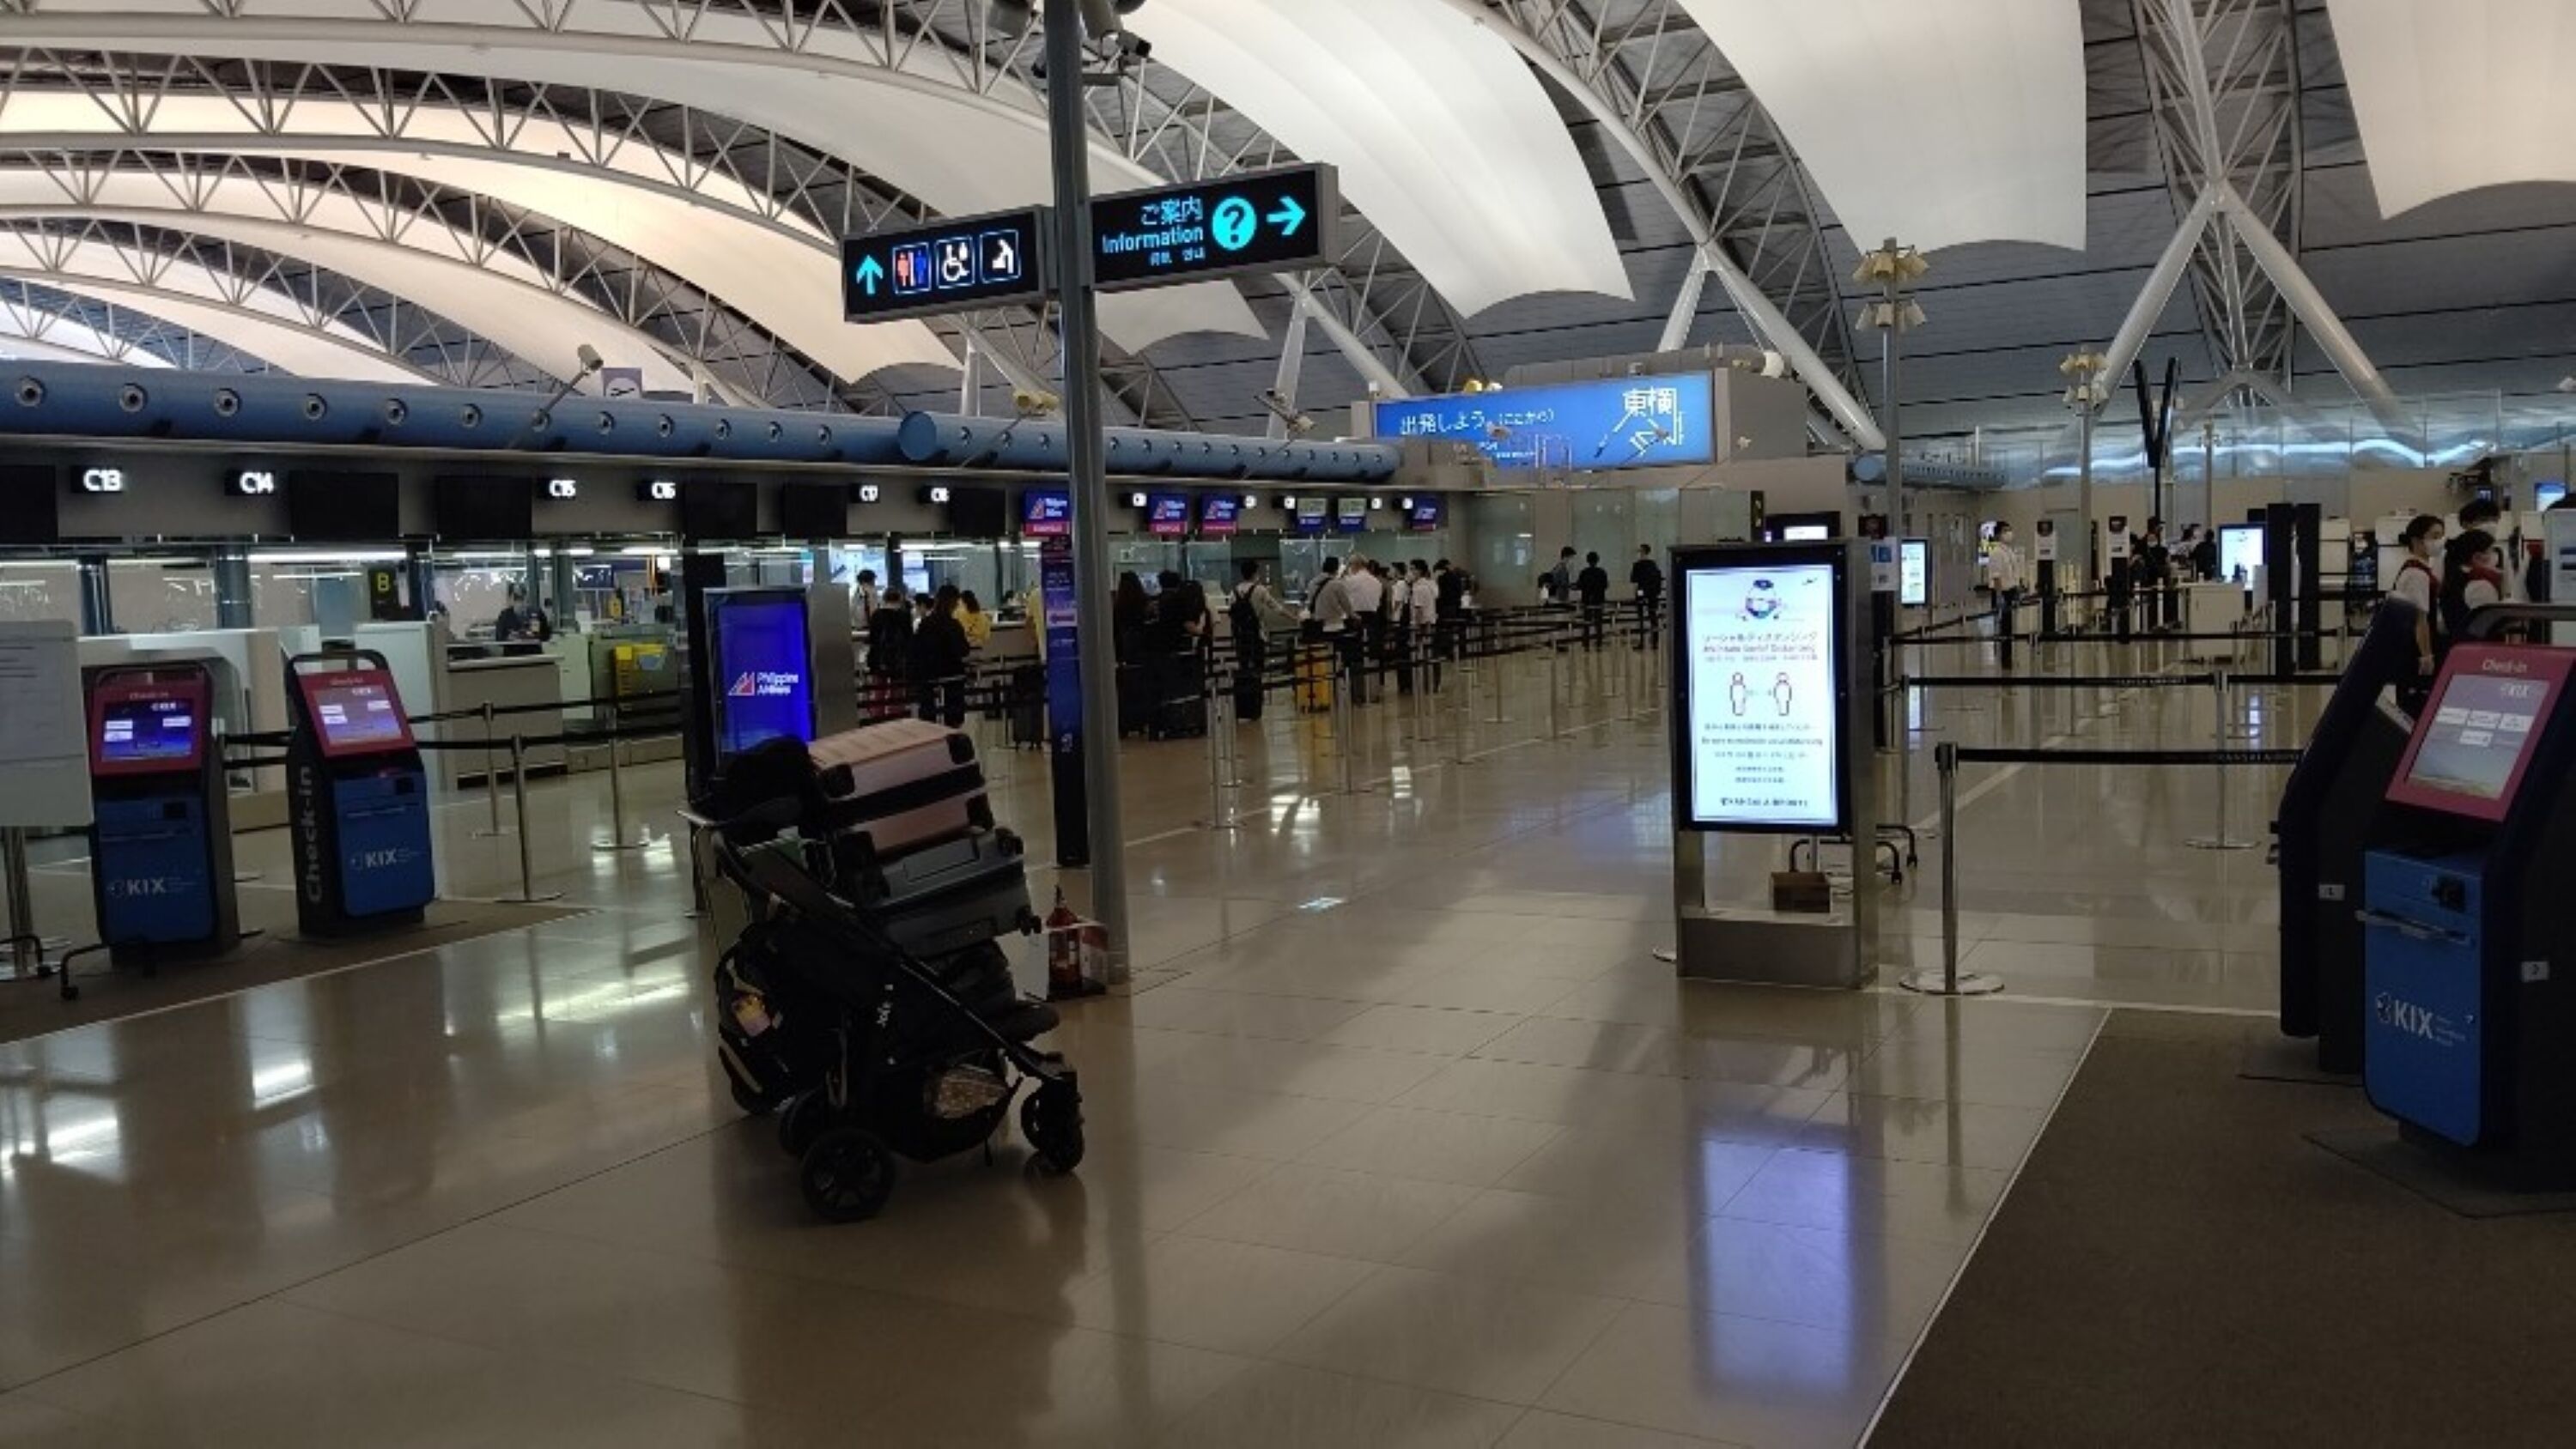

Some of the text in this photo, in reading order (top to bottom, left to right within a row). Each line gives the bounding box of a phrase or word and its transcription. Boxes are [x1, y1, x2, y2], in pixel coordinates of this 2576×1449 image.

[1141, 197, 1203, 226] ご案内
[1102, 226, 1203, 254] Information
[83, 469, 123, 491] C13
[240, 471, 274, 494] C14
[298, 766, 323, 905] Check-in
[365, 847, 398, 866] KIX
[126, 877, 167, 895] KIX
[2395, 998, 2434, 1040] KIX
